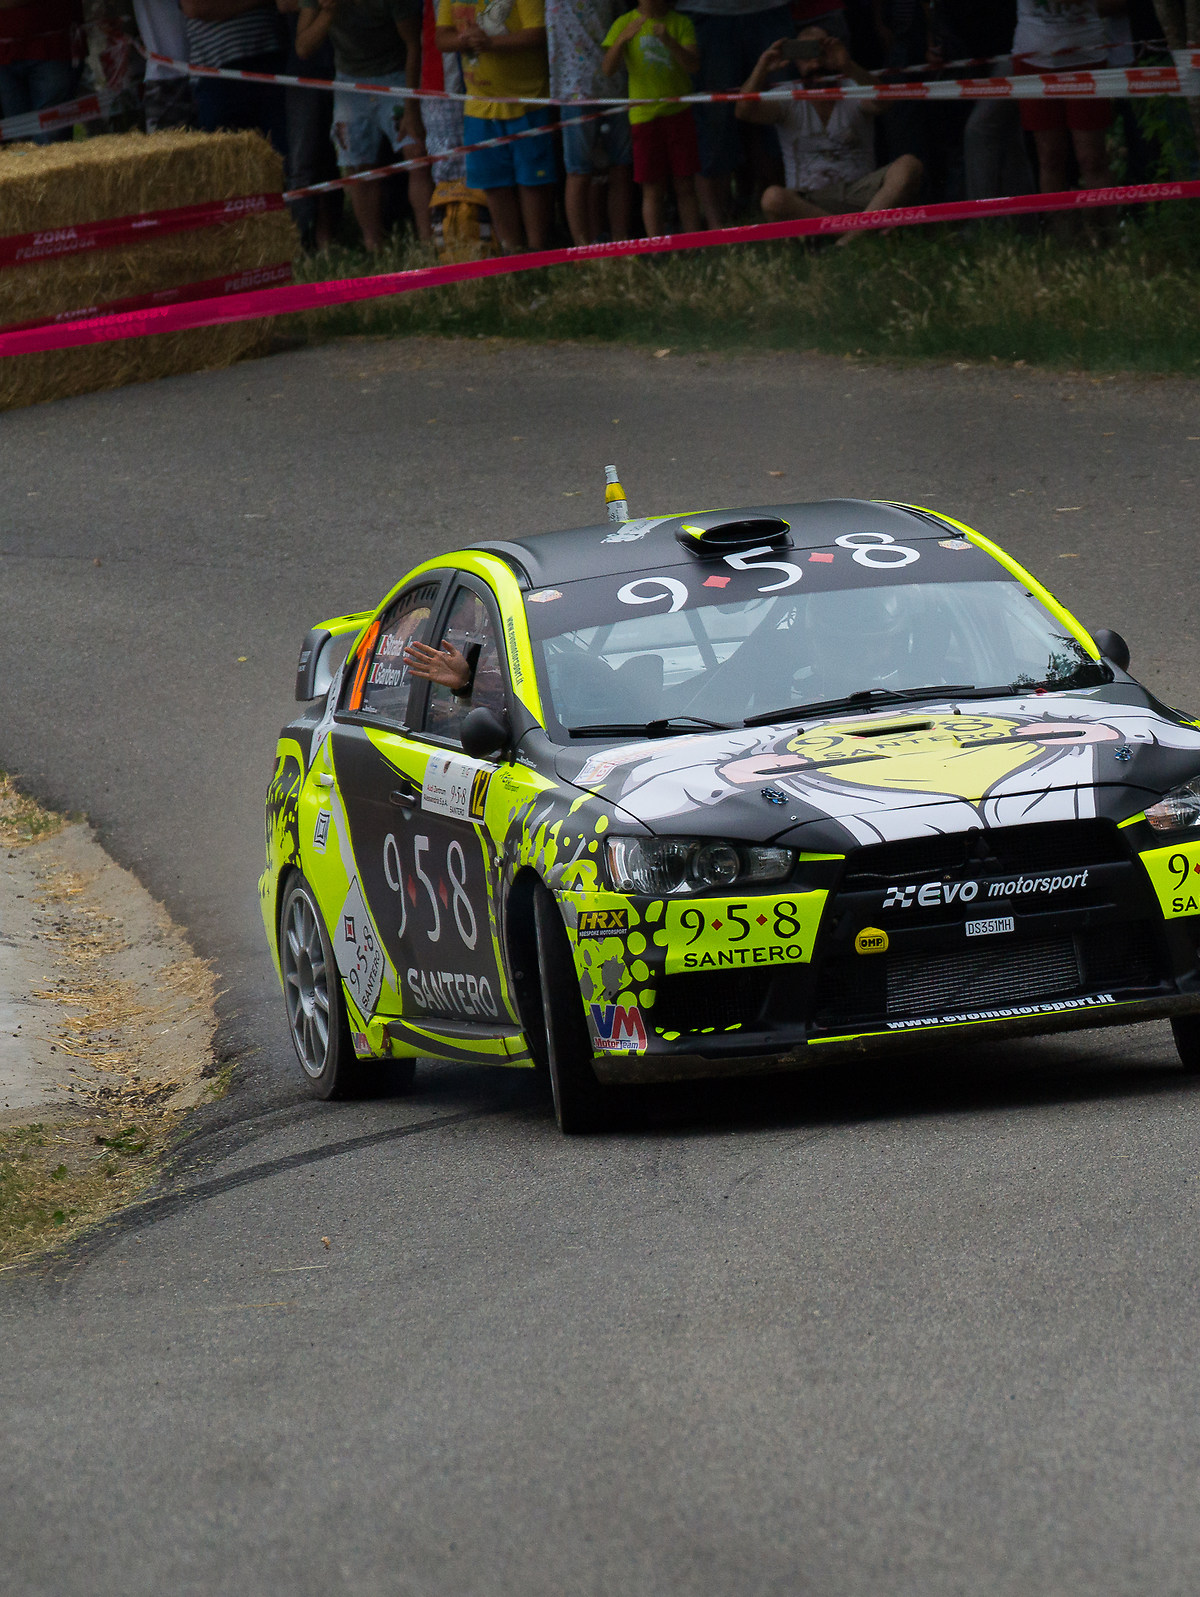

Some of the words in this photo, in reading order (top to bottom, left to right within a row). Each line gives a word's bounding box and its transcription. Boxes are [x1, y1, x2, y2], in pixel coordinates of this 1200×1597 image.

[224, 196, 268, 213] ZONA
[1075, 184, 1183, 204] PERICOLOSA
[819, 208, 927, 230] PERICOLOSA
[33, 227, 78, 246] ZONA
[15, 236, 97, 261] PERICOLOSA
[472, 769, 492, 817] 12
[987, 870, 1089, 898] motorsport
[579, 911, 625, 930] HRX
[968, 919, 1012, 935] DS351MH
[861, 938, 883, 947] OMP
[684, 944, 803, 967] SANTERO
[361, 950, 381, 1008] SANTERO
[407, 967, 499, 1017] SANTERO
[886, 993, 1117, 1030] www.evomotorsport.it
[590, 1003, 648, 1051] VM
